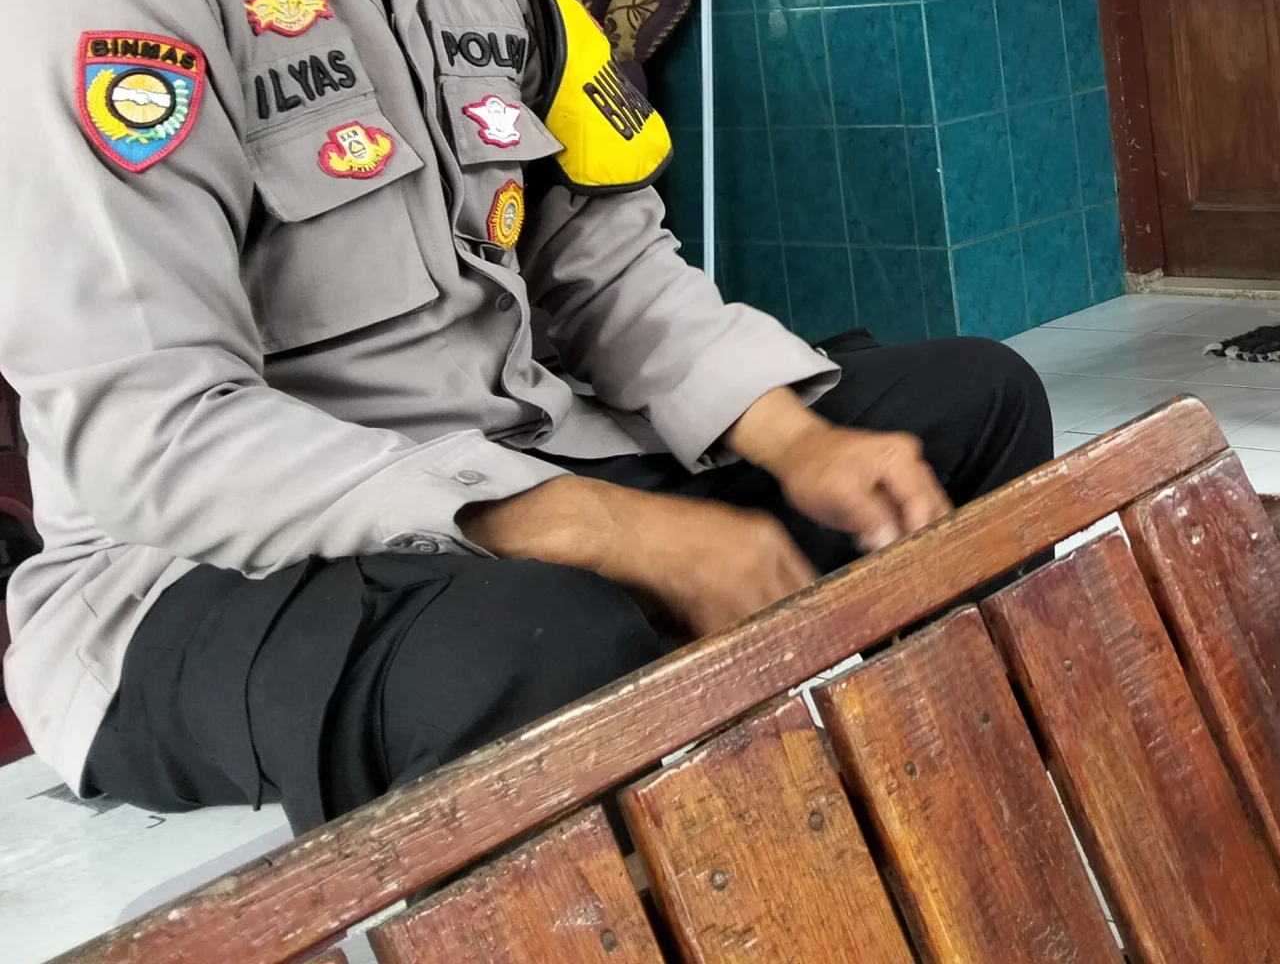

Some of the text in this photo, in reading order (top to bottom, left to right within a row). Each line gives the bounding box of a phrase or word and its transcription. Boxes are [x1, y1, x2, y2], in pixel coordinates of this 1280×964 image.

[90, 38, 196, 70] BINMAS
[254, 49, 357, 120] ILYAS
[340, 130, 360, 142] SAR
